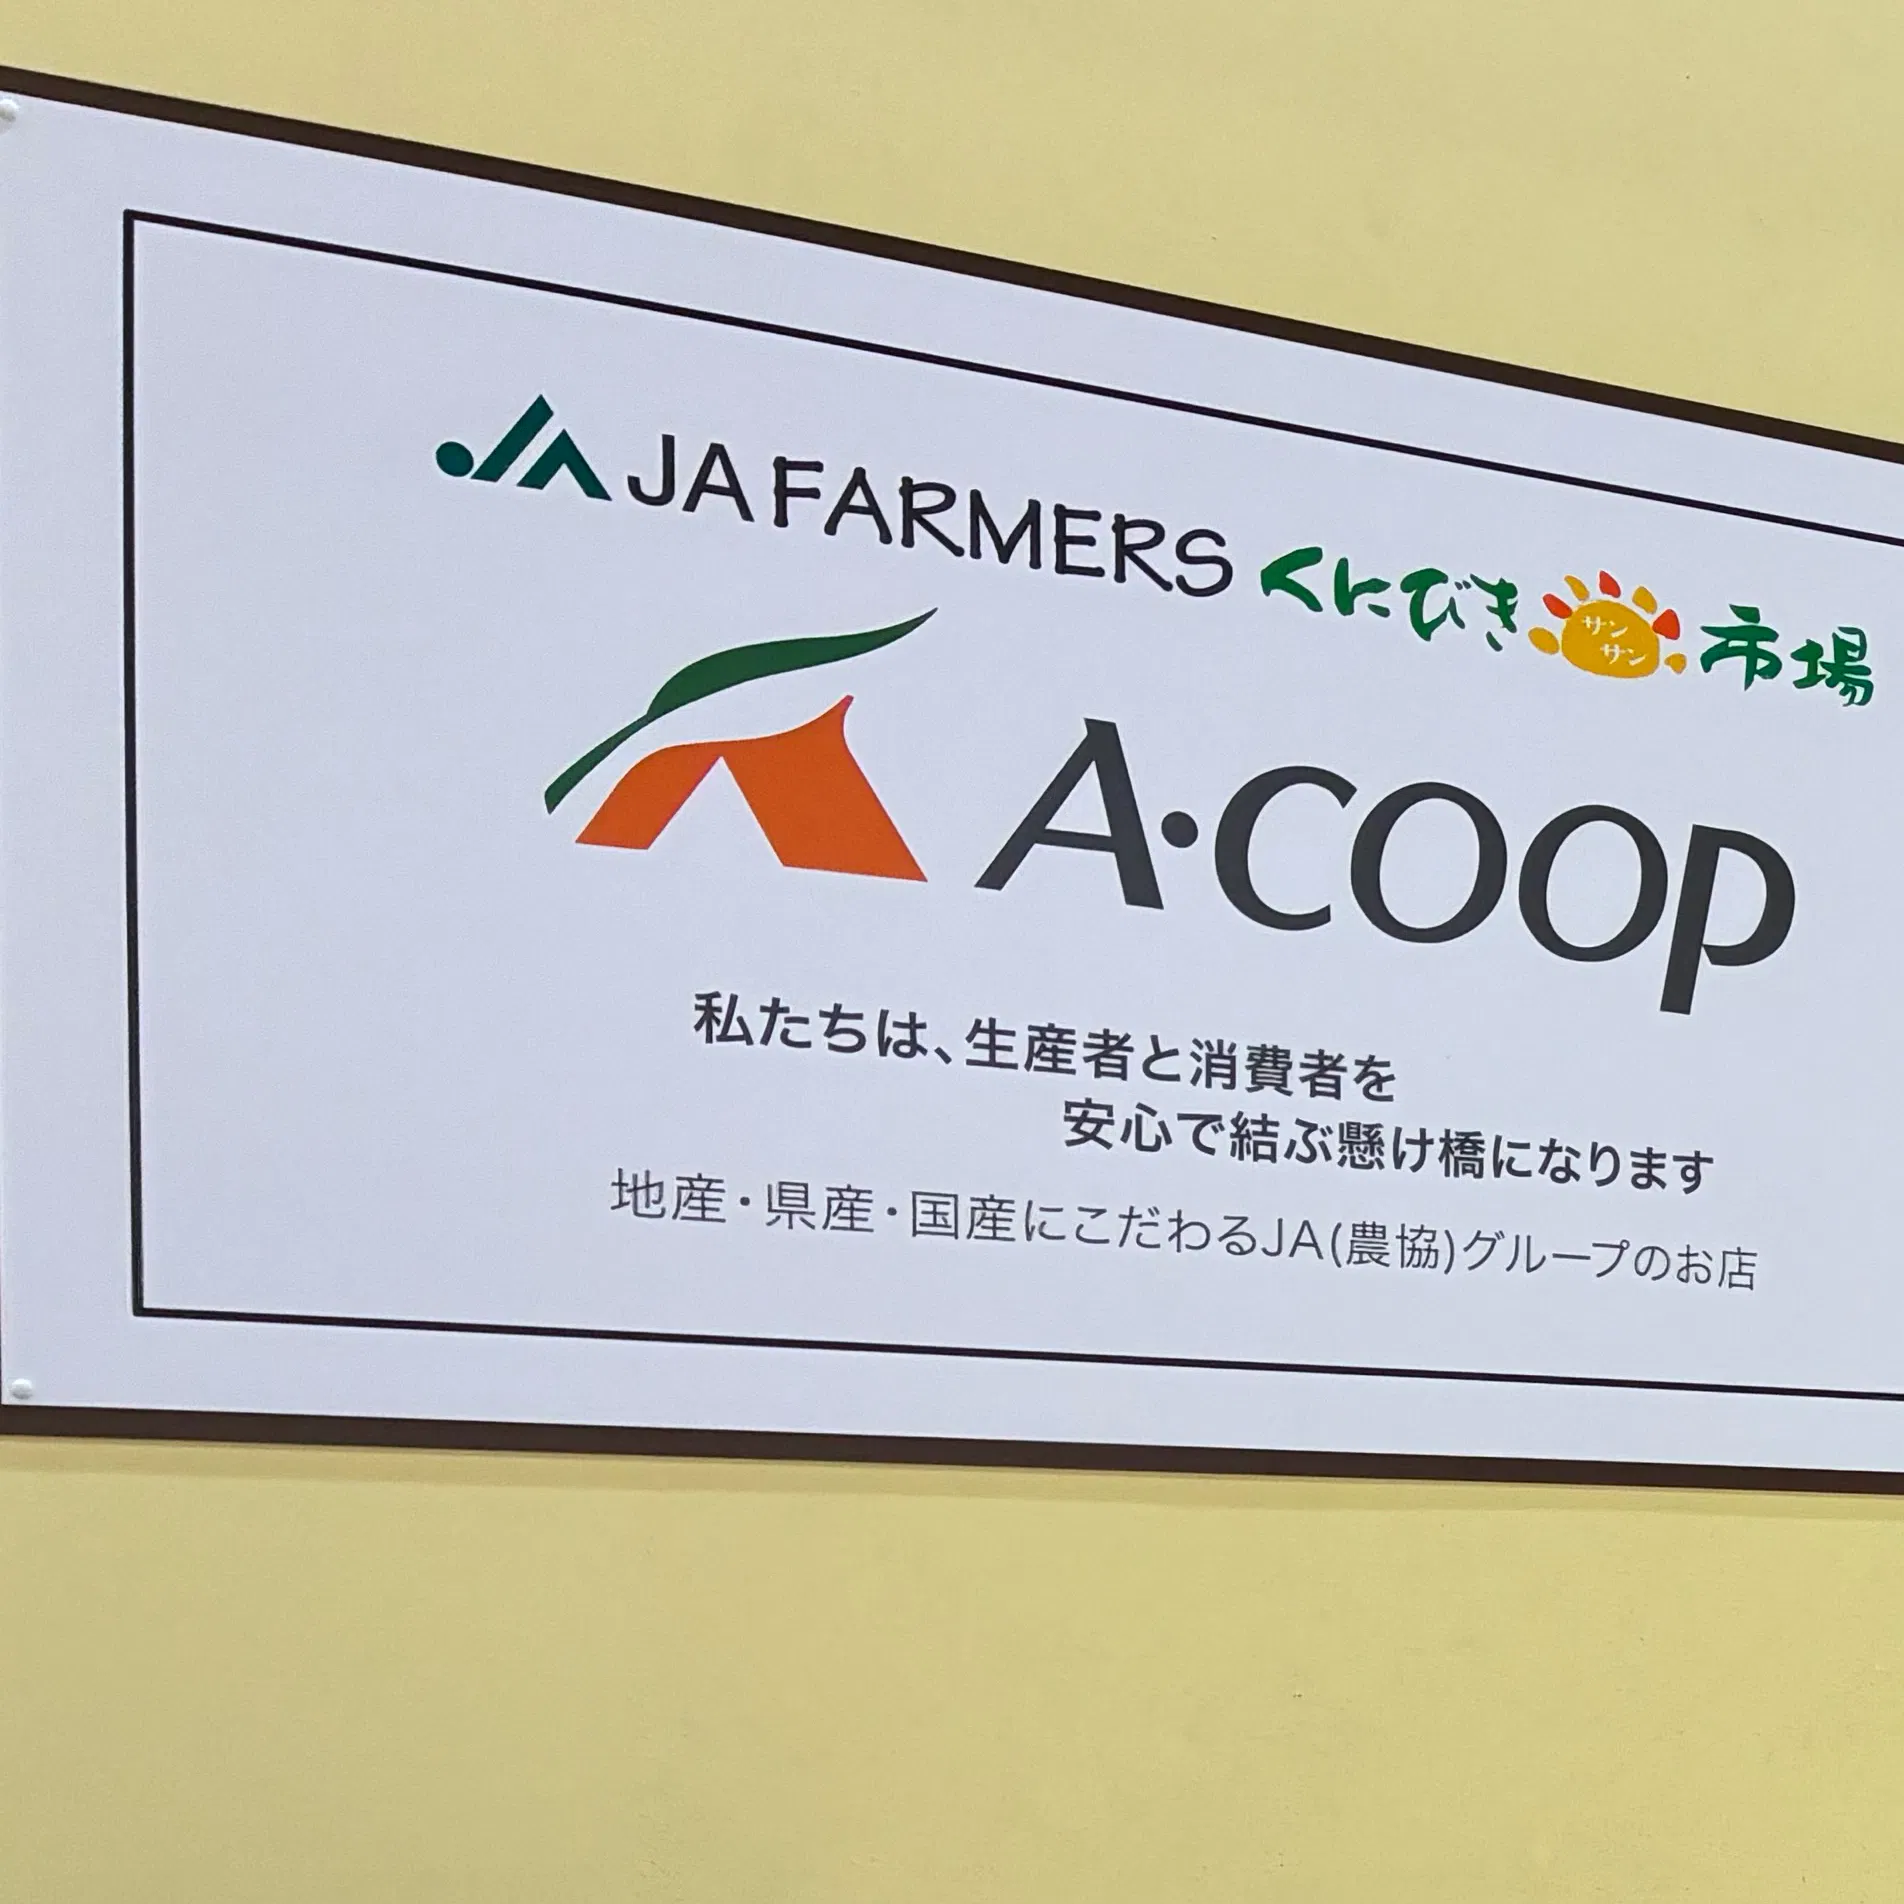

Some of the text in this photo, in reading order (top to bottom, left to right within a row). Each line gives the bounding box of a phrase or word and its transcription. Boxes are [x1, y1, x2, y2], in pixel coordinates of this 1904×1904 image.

[628, 434, 1875, 707] JA FARMERS くにびき 市場
[1582, 615, 1628, 639] サン
[1600, 643, 1648, 666] サン
[693, 988, 1397, 1103] 私たちは、生産者と消費者を
[1062, 1097, 1715, 1196] 安心で結ぶ懸け橋になります
